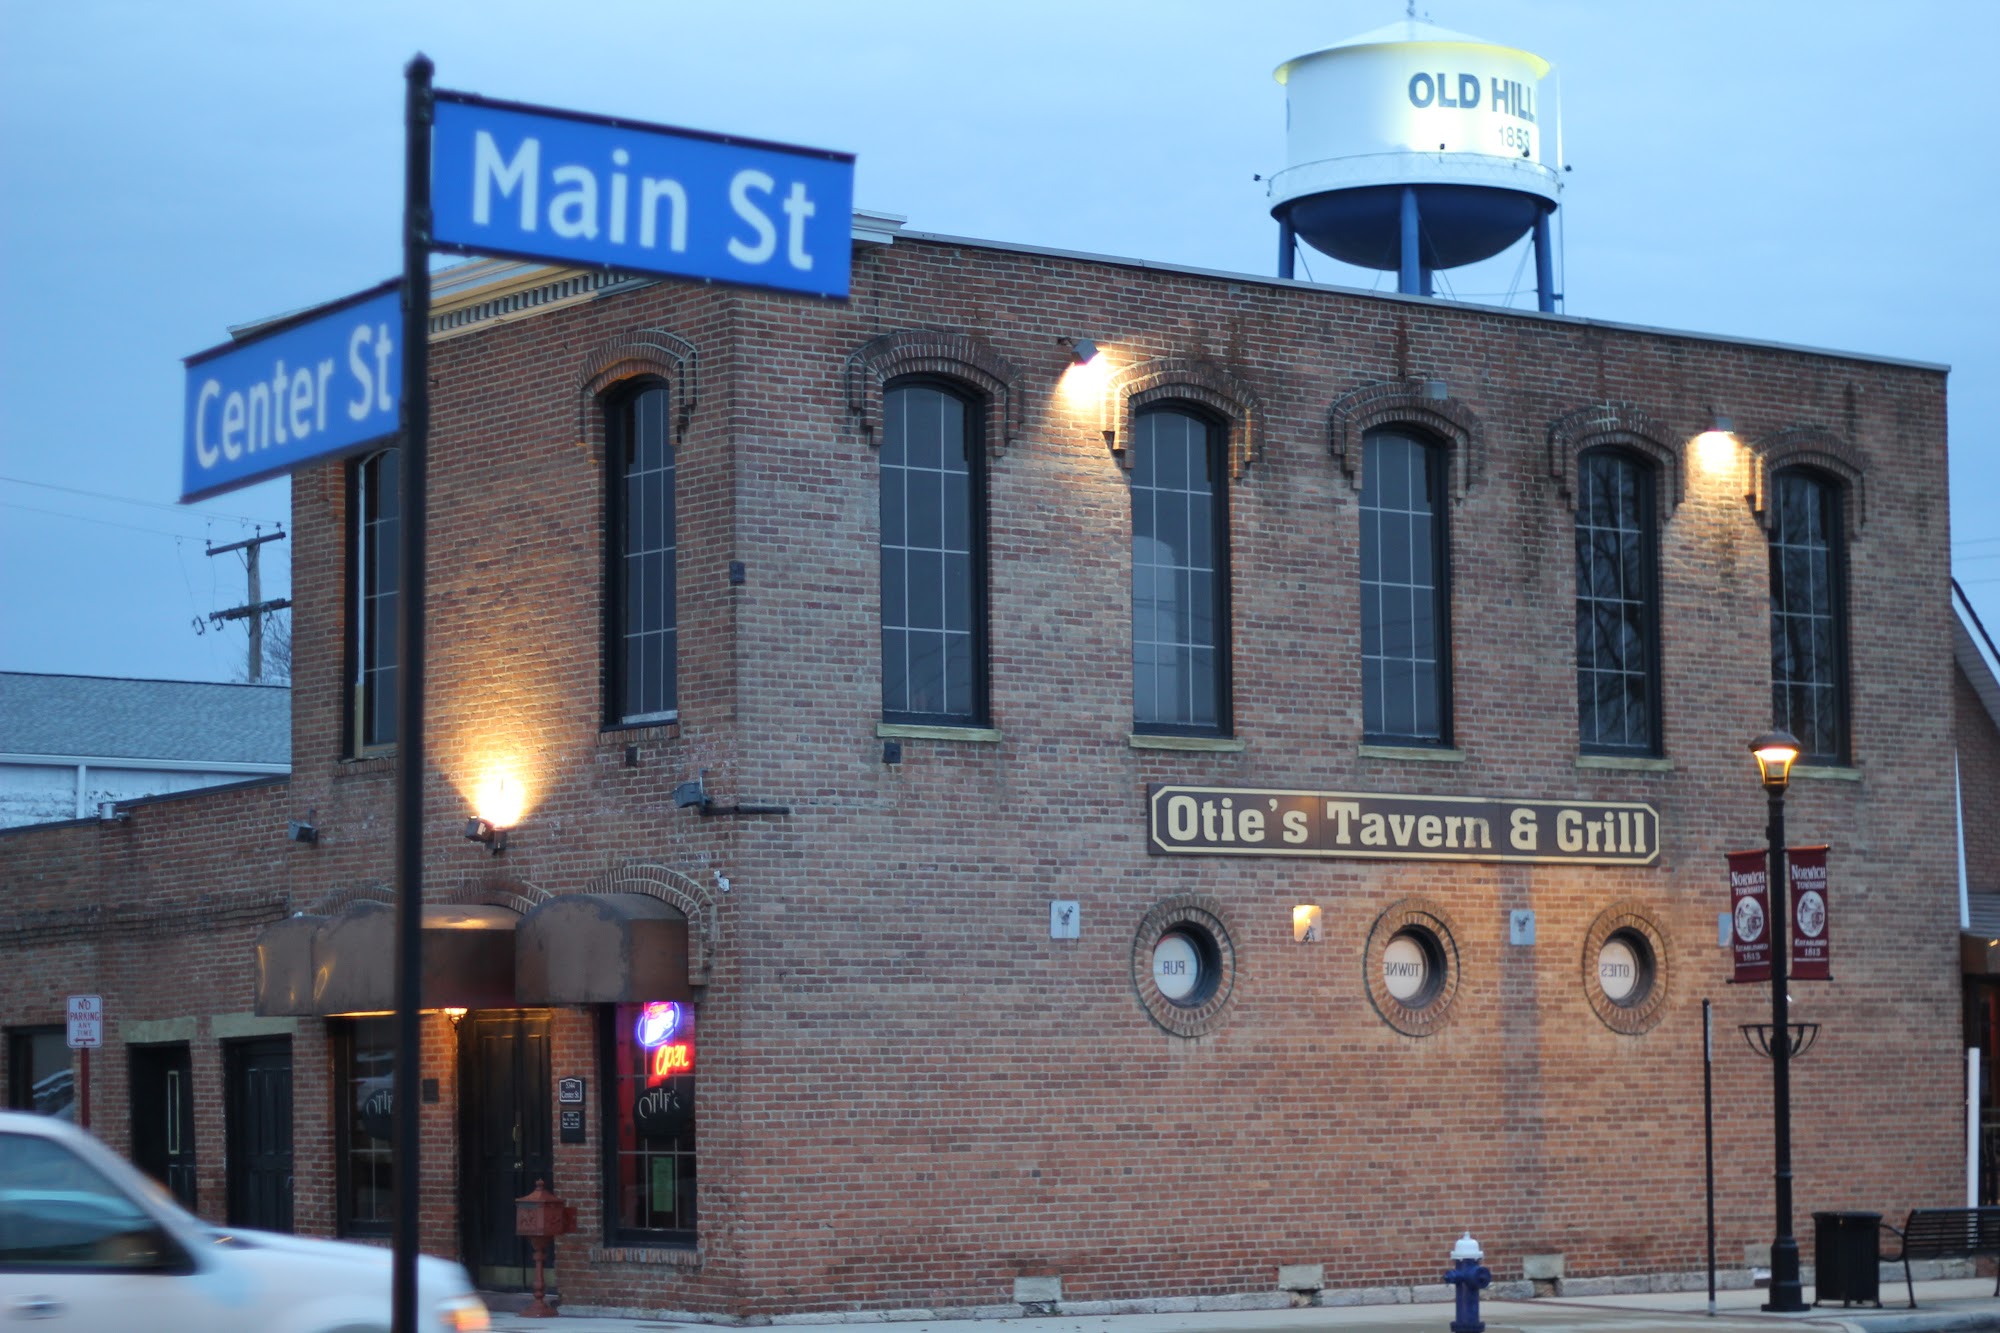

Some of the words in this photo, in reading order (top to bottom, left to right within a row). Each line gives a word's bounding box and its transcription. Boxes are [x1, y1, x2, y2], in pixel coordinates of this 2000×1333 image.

[1408, 72, 1480, 109] OLD
[1499, 125, 1530, 151] 1853
[472, 131, 688, 253] Main
[726, 169, 815, 271] St
[197, 357, 334, 469] Center
[348, 323, 393, 422] St
[1167, 795, 1309, 843] Otie's
[1326, 801, 1492, 849] Tavern
[1510, 807, 1538, 850] &
[1556, 809, 1647, 853] Grill
[70, 1012, 99, 1021] PARKING
[78, 1001, 91, 1010] NO
[656, 1045, 689, 1075] Open
